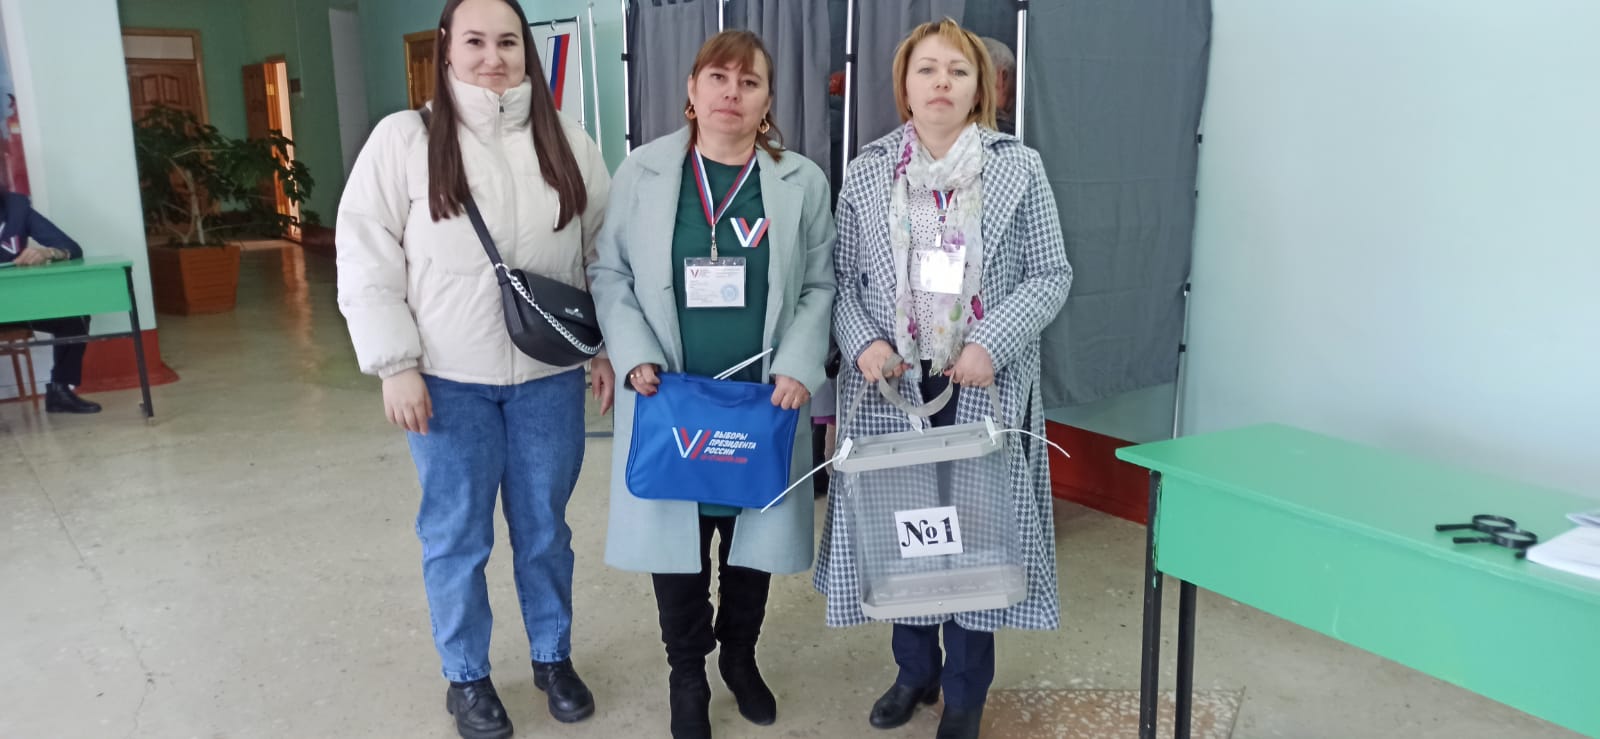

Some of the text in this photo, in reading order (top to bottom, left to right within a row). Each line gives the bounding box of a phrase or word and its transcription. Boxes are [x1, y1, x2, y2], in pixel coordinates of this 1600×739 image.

[714, 431, 748, 441] ВЫБОРЫ
[709, 439, 756, 449] ПРЕЗИДЕНТА
[704, 447, 735, 456] РОССИИ
